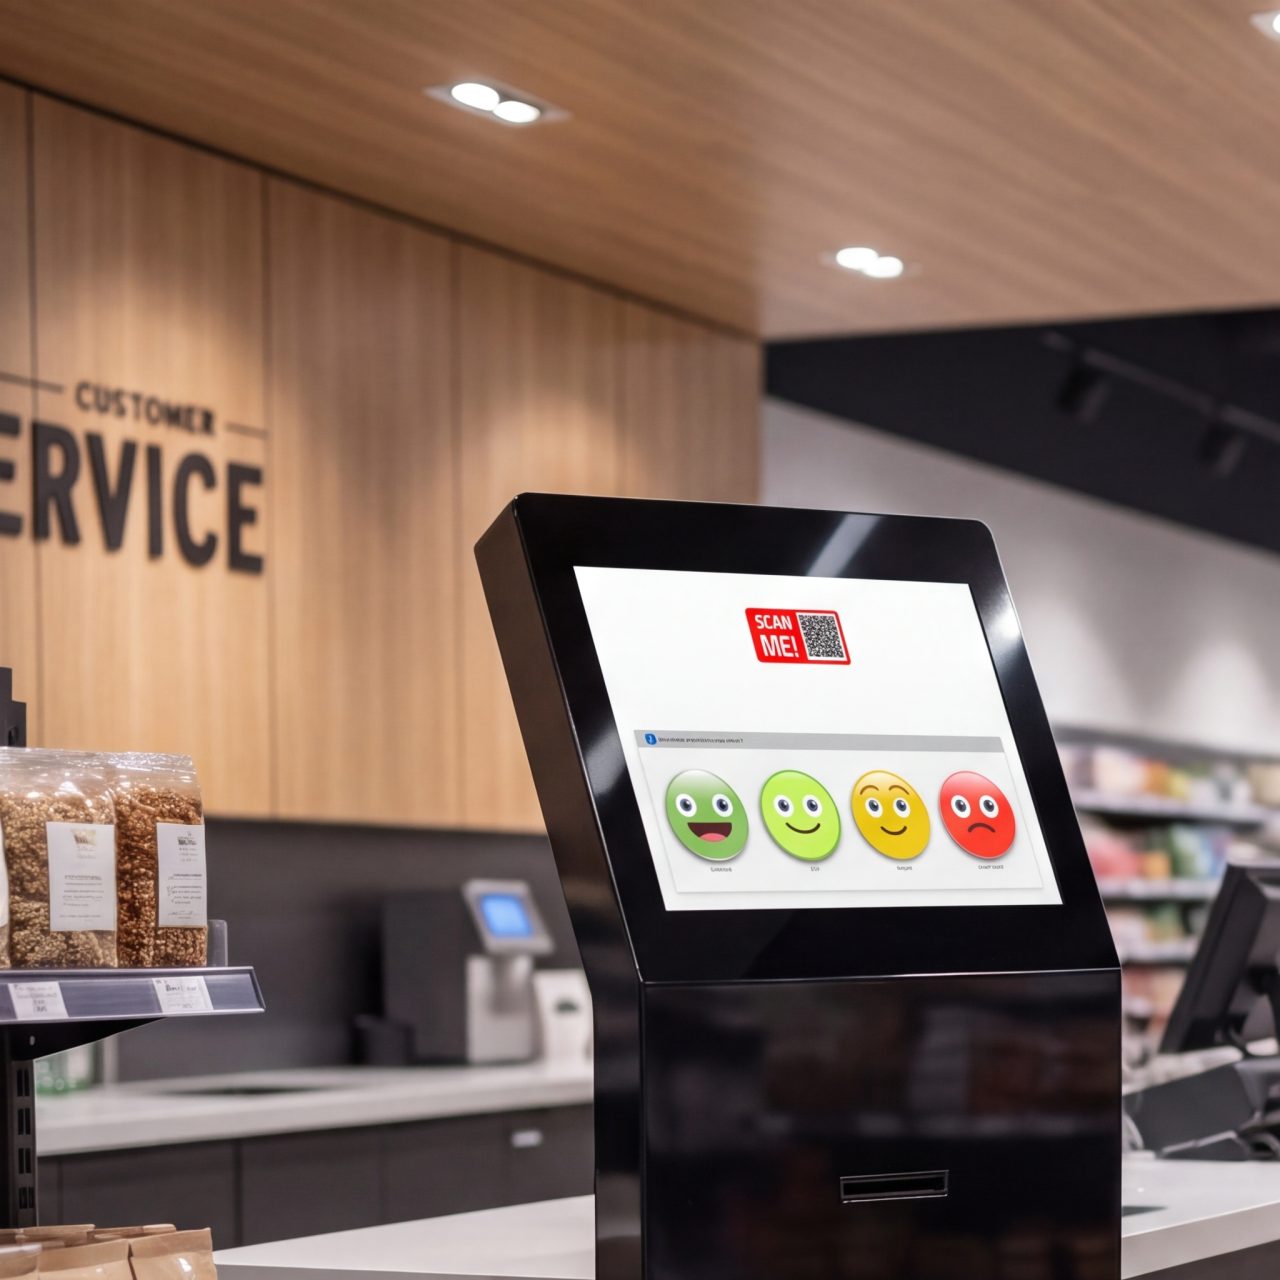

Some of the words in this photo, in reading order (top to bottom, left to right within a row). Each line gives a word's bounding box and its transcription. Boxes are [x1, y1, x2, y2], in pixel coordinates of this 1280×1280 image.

[75, 380, 215, 435] CUSTOMER
[754, 614, 793, 630] SCAN
[760, 634, 800, 658] ME!
